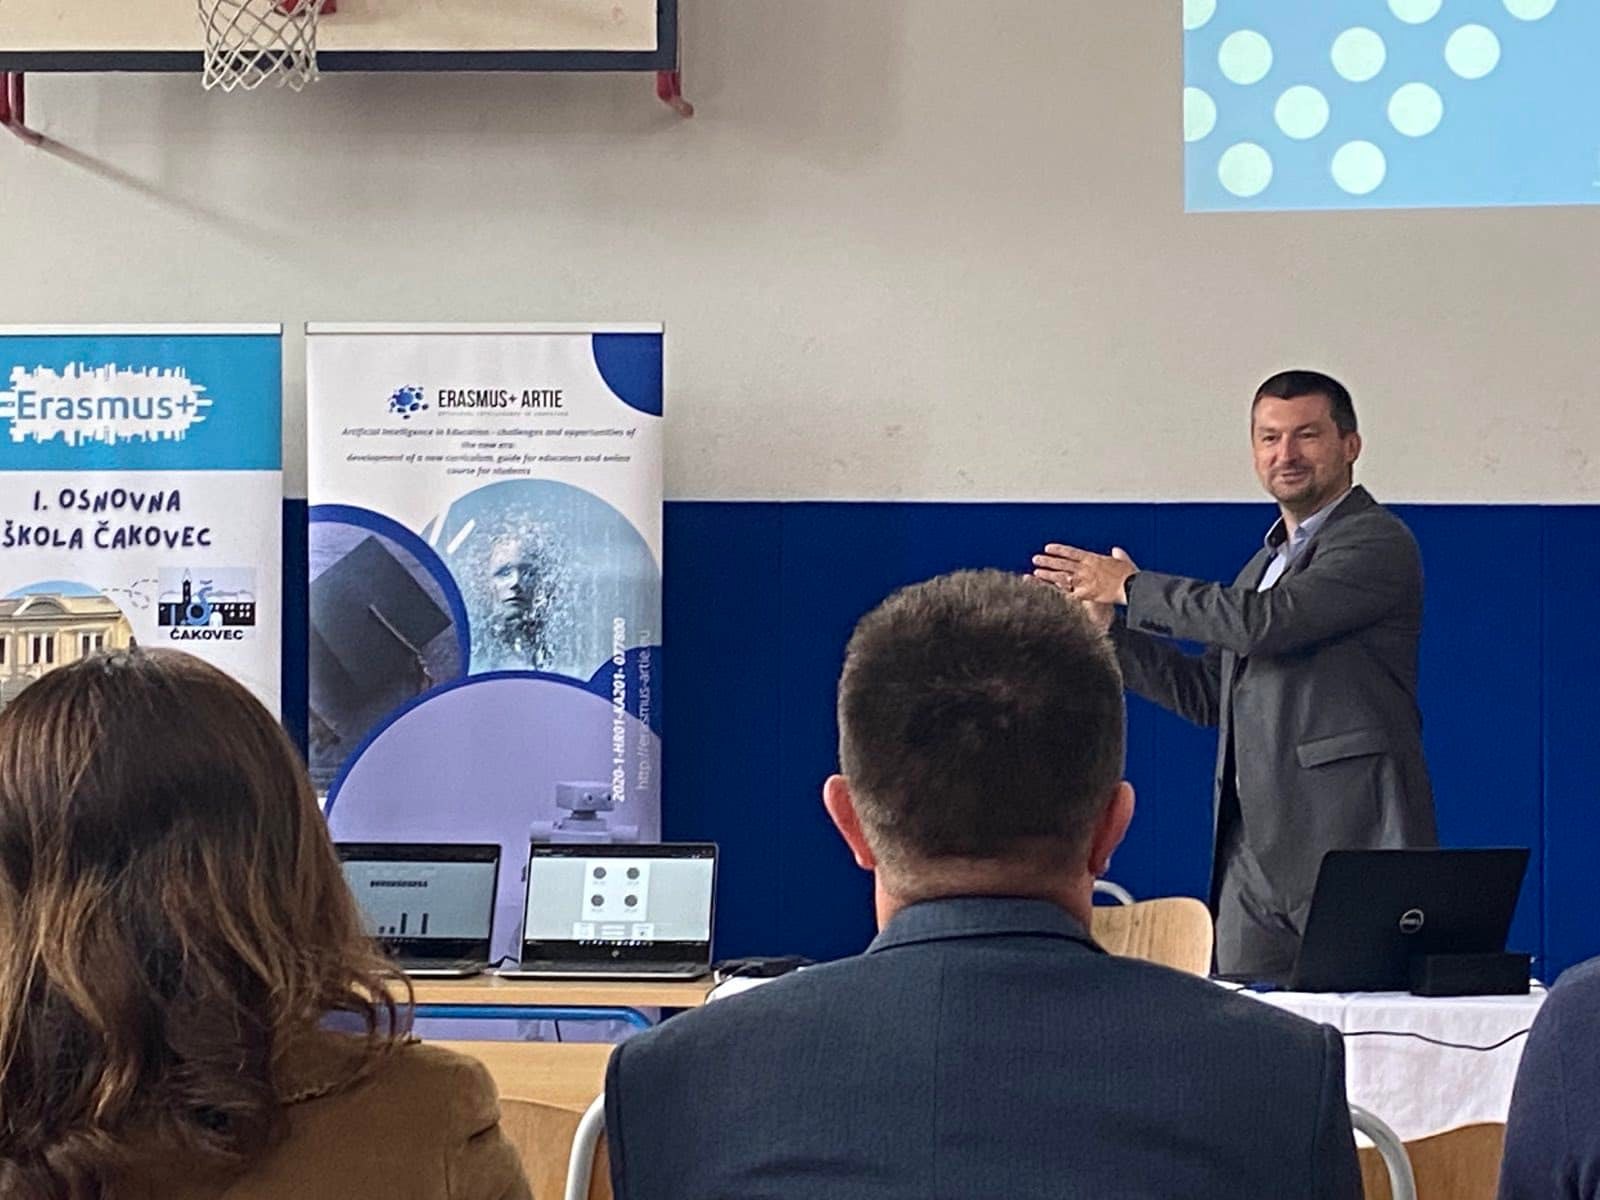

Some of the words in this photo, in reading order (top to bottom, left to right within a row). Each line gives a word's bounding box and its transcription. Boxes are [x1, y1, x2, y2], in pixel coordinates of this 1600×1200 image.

[17, 390, 195, 420] Erasmus+
[438, 390, 518, 408] ERASMUS+
[521, 390, 563, 408] ARTIE
[545, 427, 562, 435] and
[626, 428, 636, 438] of
[405, 454, 416, 463] of
[522, 454, 537, 463] for
[476, 466, 490, 477] for
[59, 488, 181, 513] OSNOVNA
[2, 520, 83, 549] ŠKOLA
[94, 520, 212, 549] ČAKOVEC
[170, 627, 244, 640] ČAKOVEC
